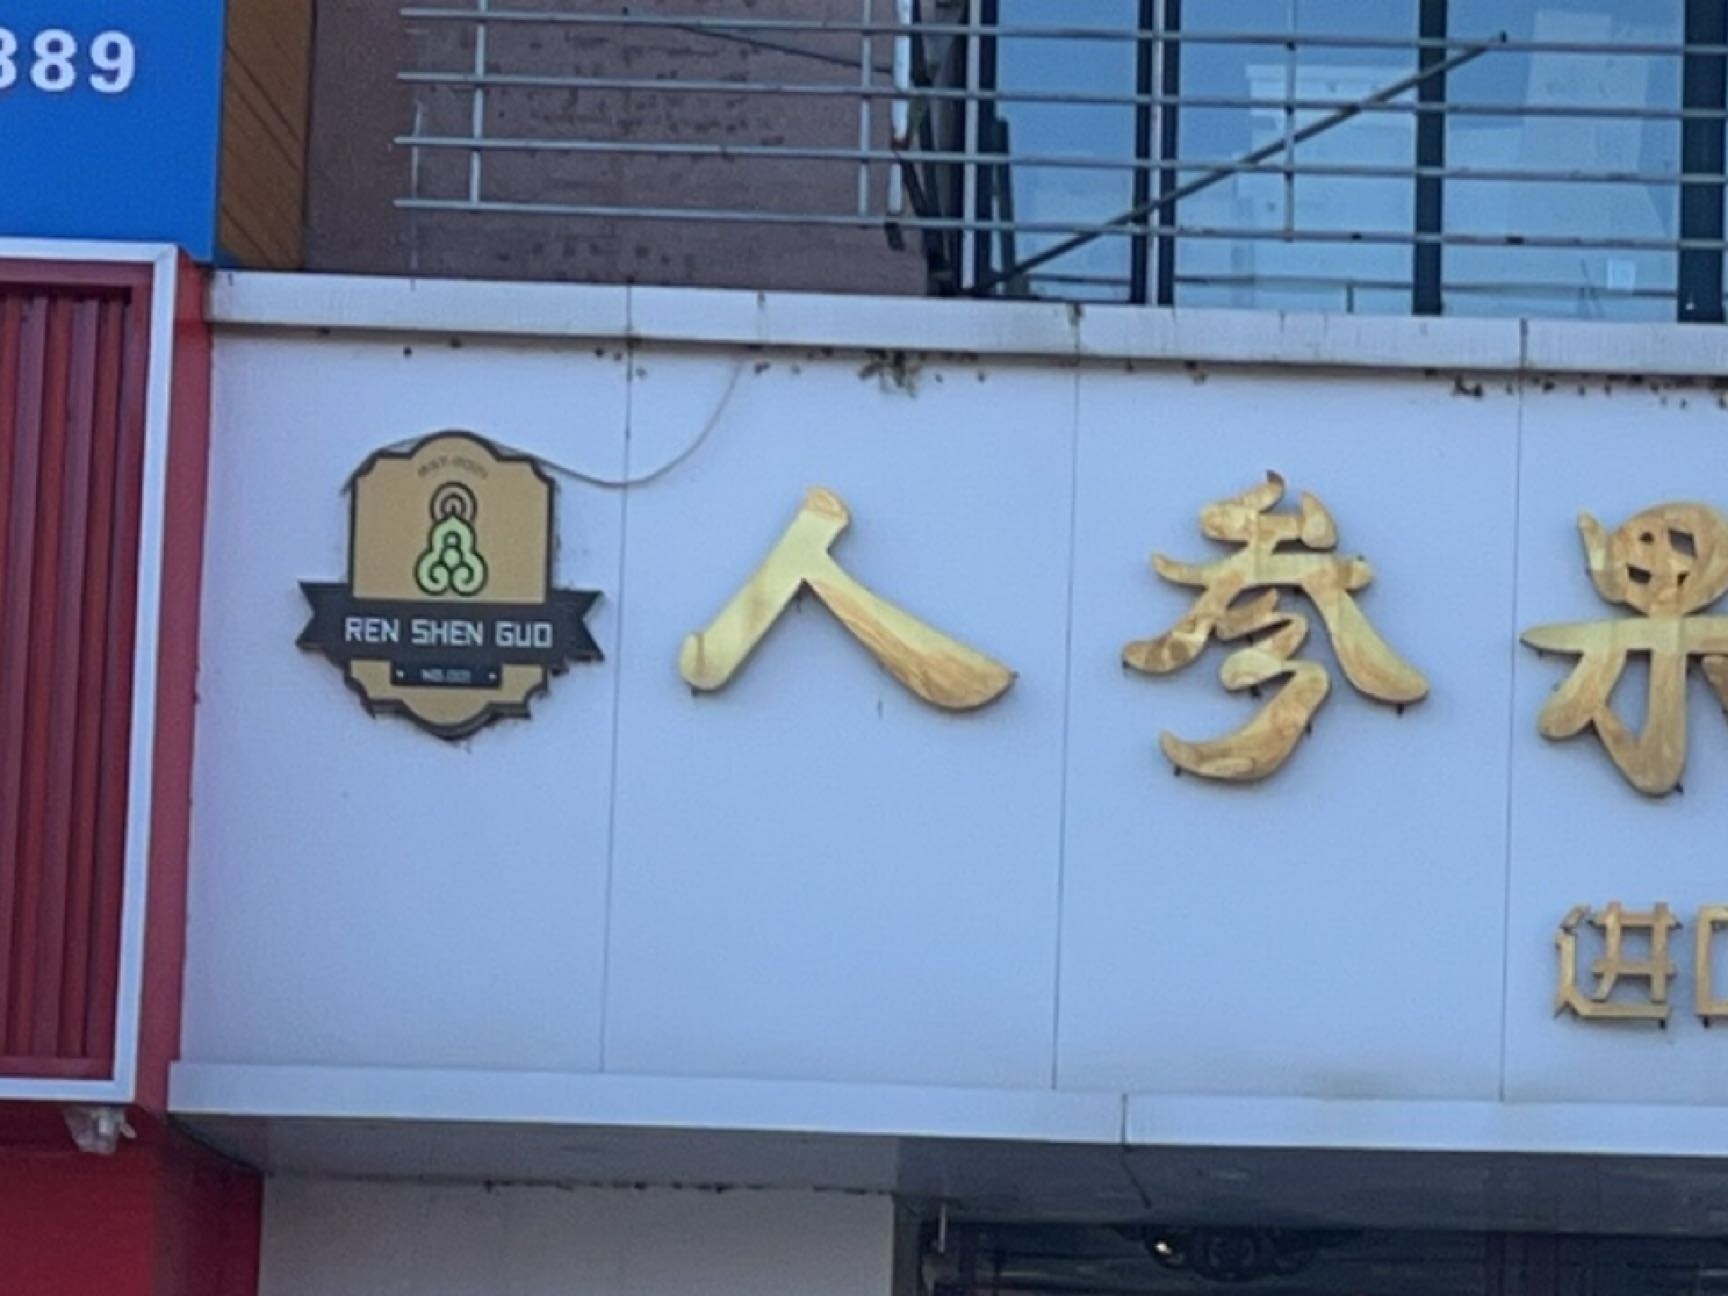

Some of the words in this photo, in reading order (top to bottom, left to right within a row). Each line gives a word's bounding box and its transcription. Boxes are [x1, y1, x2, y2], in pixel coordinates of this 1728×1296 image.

[345, 617, 399, 642] REN
[411, 619, 483, 646] SHEN
[496, 621, 553, 648] GUO
